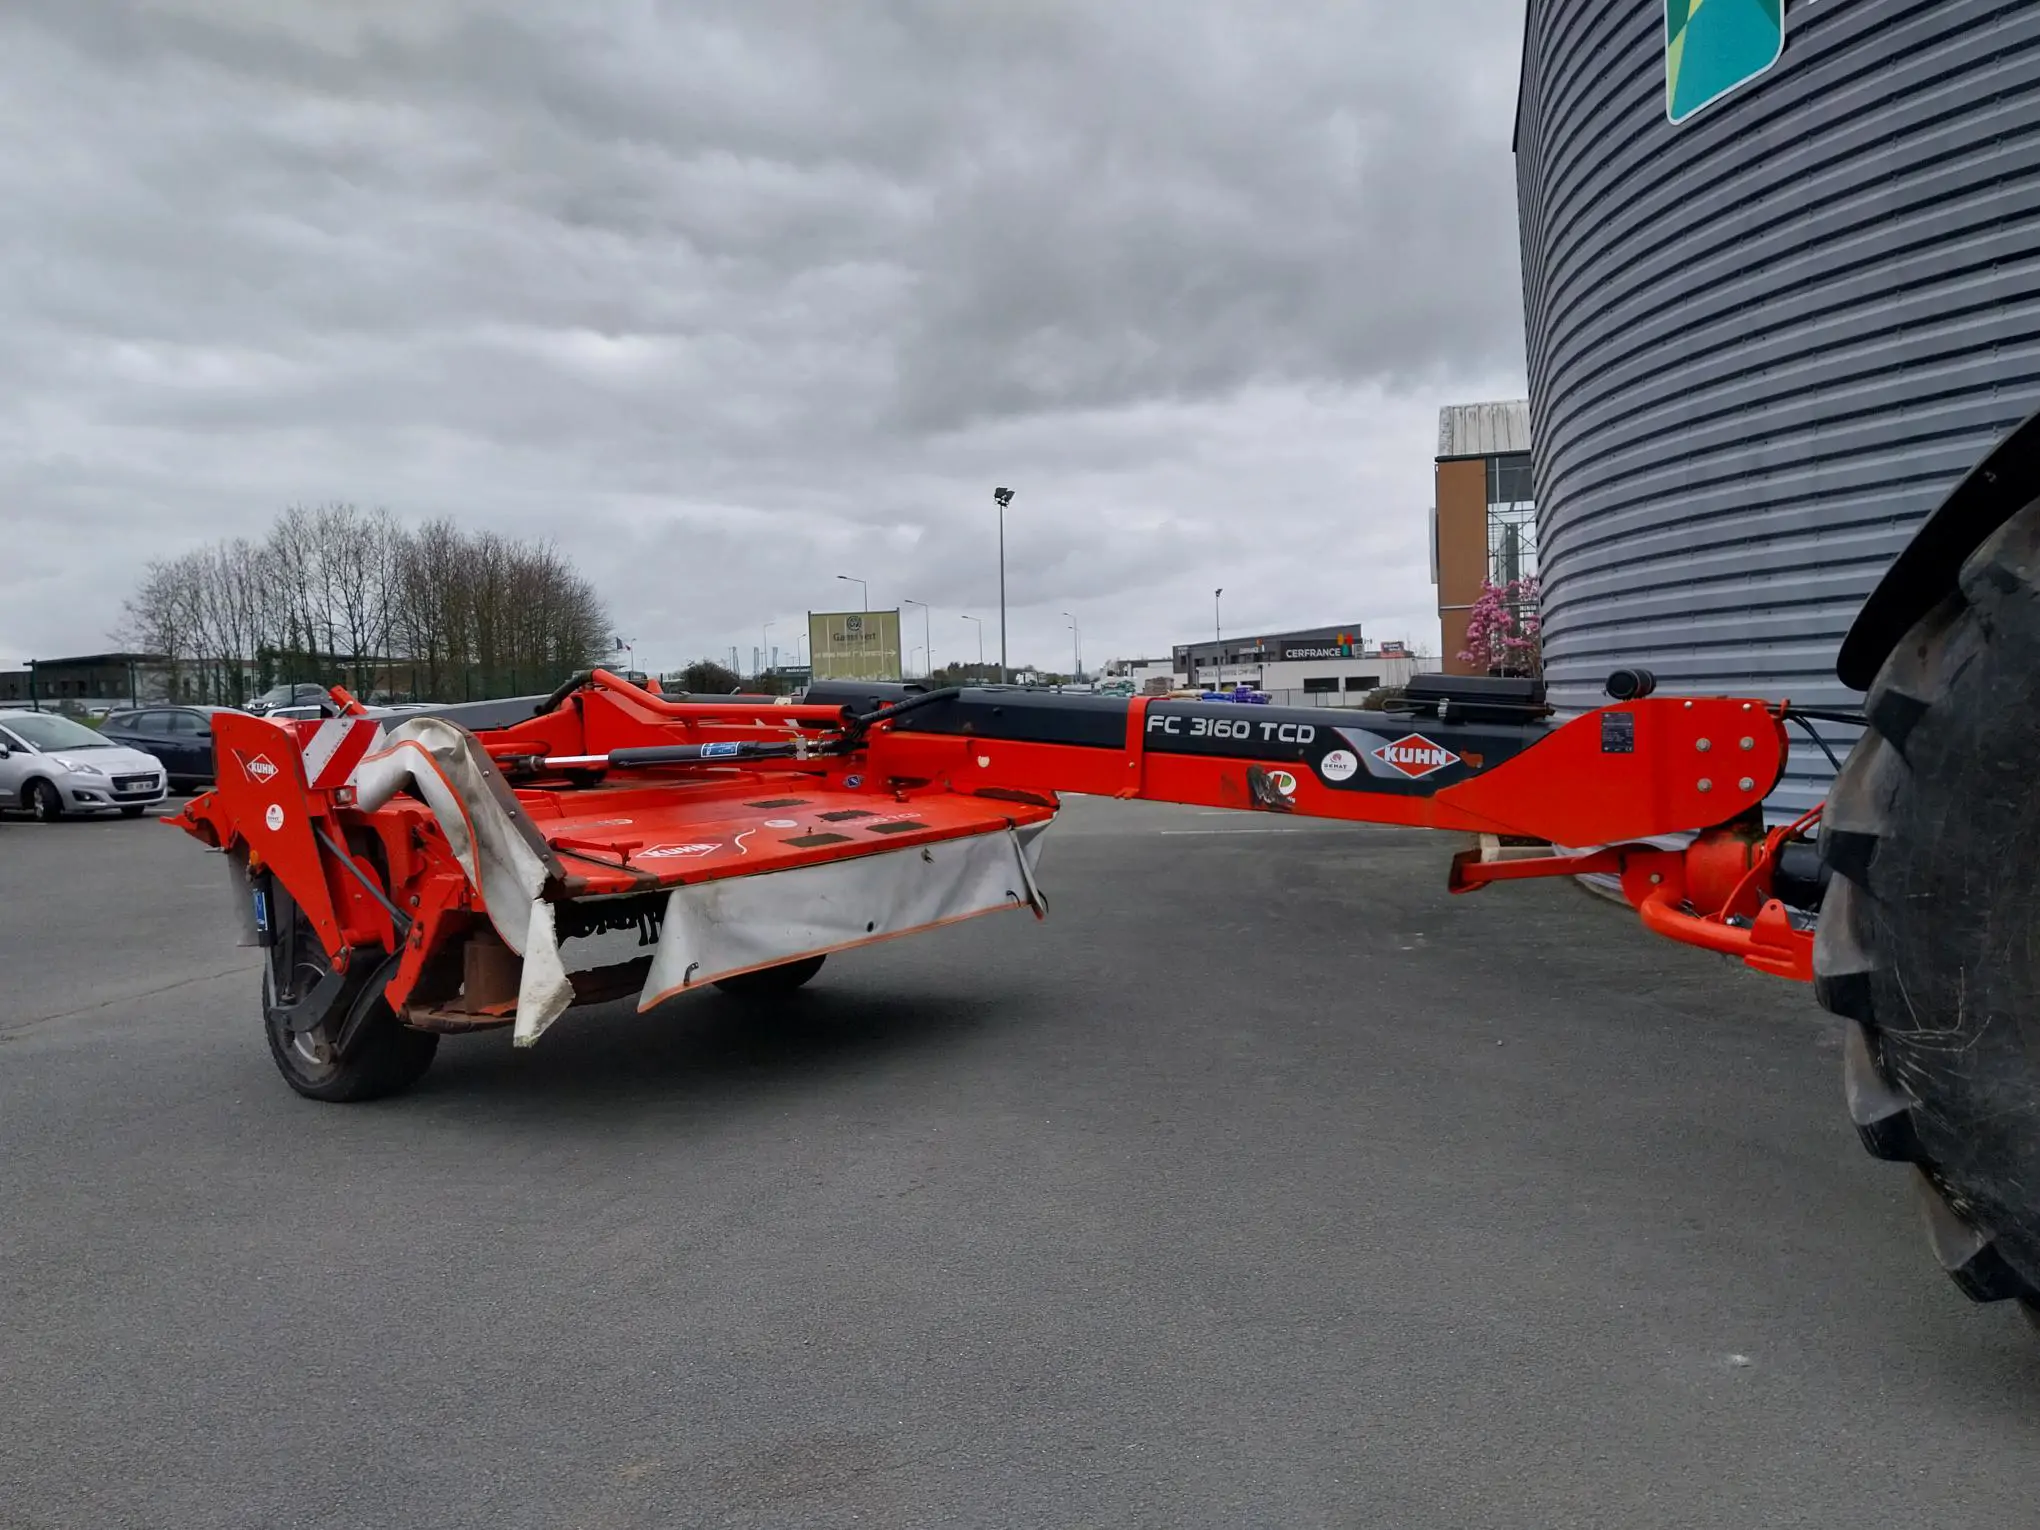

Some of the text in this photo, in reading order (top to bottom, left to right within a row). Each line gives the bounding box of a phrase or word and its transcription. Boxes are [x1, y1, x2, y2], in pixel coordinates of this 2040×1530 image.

[1286, 647, 1341, 658] CERFRANCE
[1146, 715, 1316, 744] FC 3160 TCD
[1384, 745, 1447, 766] KUHN
[251, 762, 274, 775] KUHN
[644, 844, 714, 857] KUHN
